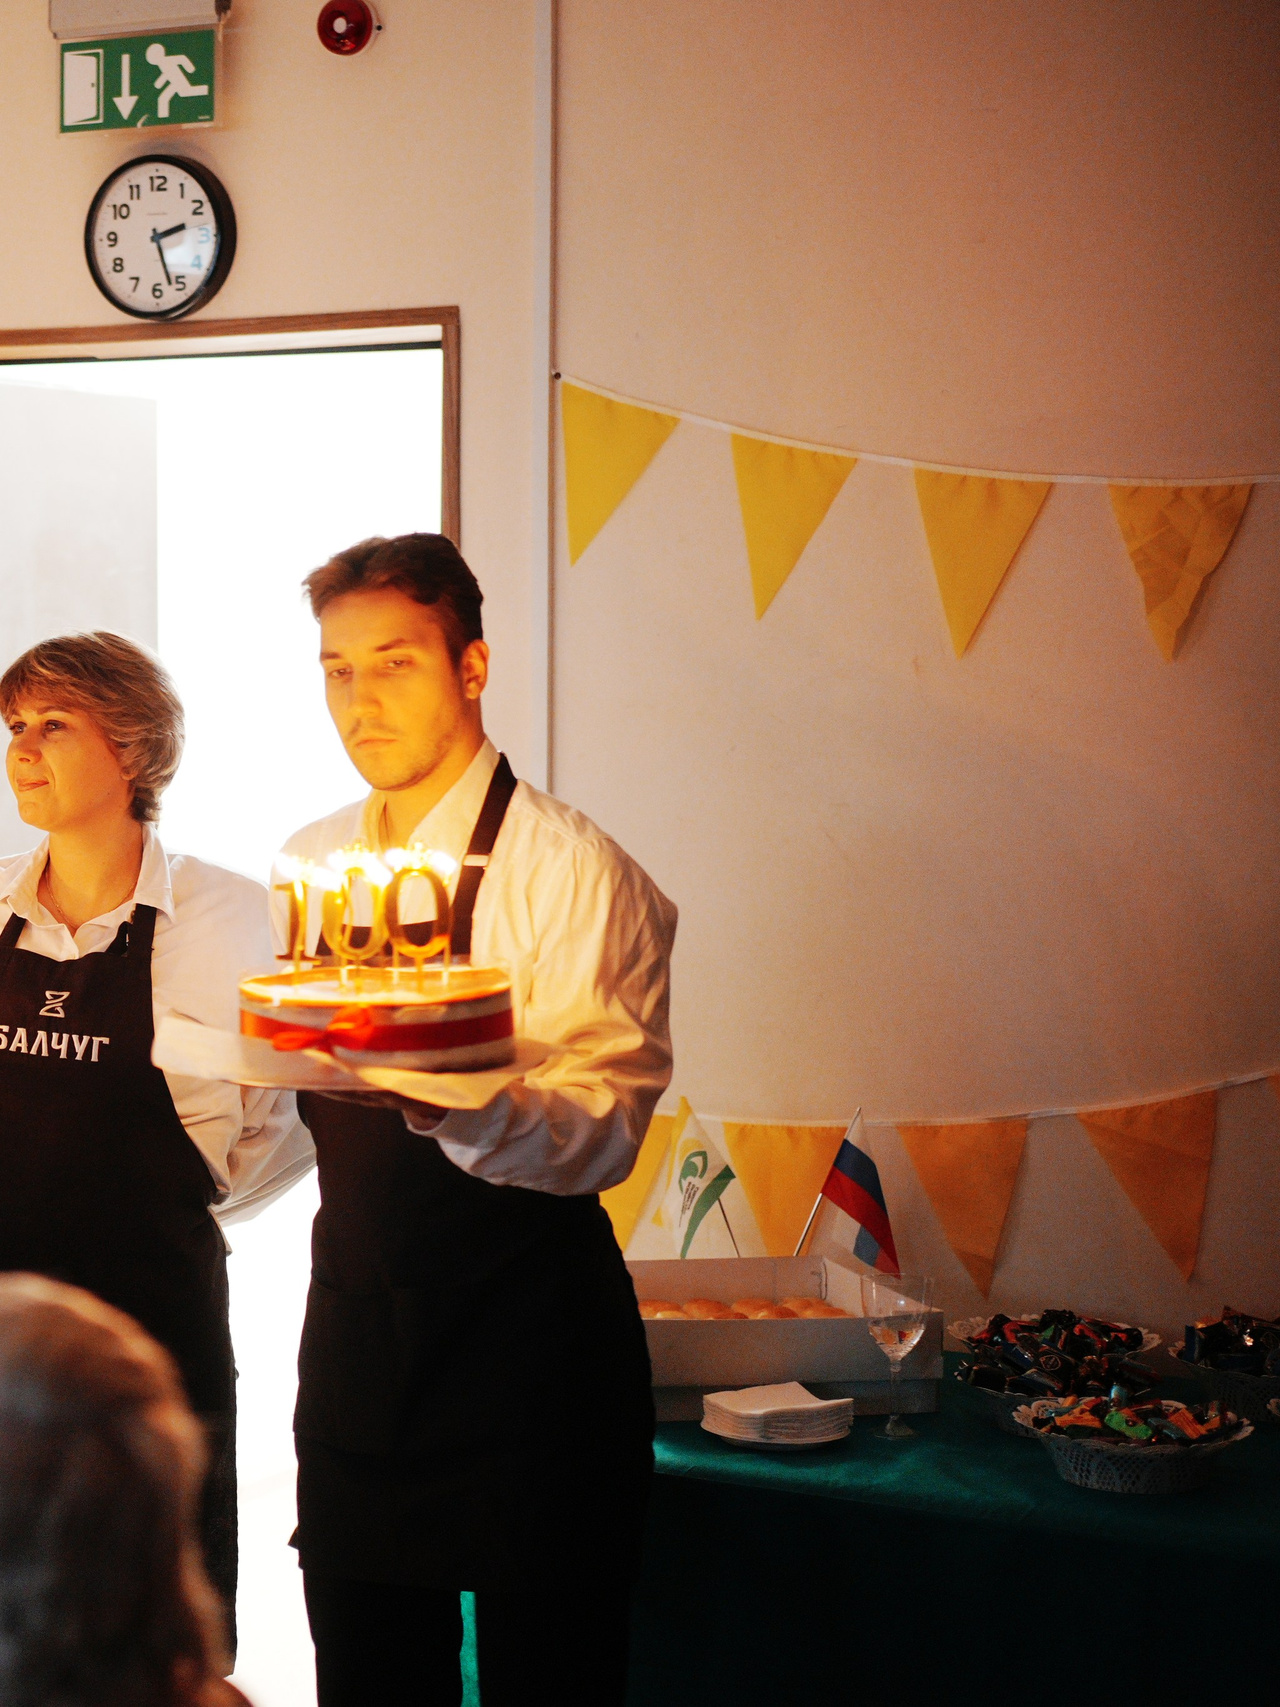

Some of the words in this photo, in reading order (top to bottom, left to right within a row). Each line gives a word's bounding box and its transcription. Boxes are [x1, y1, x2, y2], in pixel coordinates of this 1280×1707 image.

[149, 175, 168, 192] 12
[179, 183, 185, 199] 1
[129, 184, 141, 200] 11
[112, 203, 130, 220] 10
[191, 199, 204, 216] 2
[107, 231, 118, 248] 9
[198, 227, 211, 244] 3
[112, 257, 124, 273] 8
[190, 254, 203, 270] 4
[129, 276, 140, 293] 7
[151, 283, 163, 299] 6
[175, 275, 186, 291] 5
